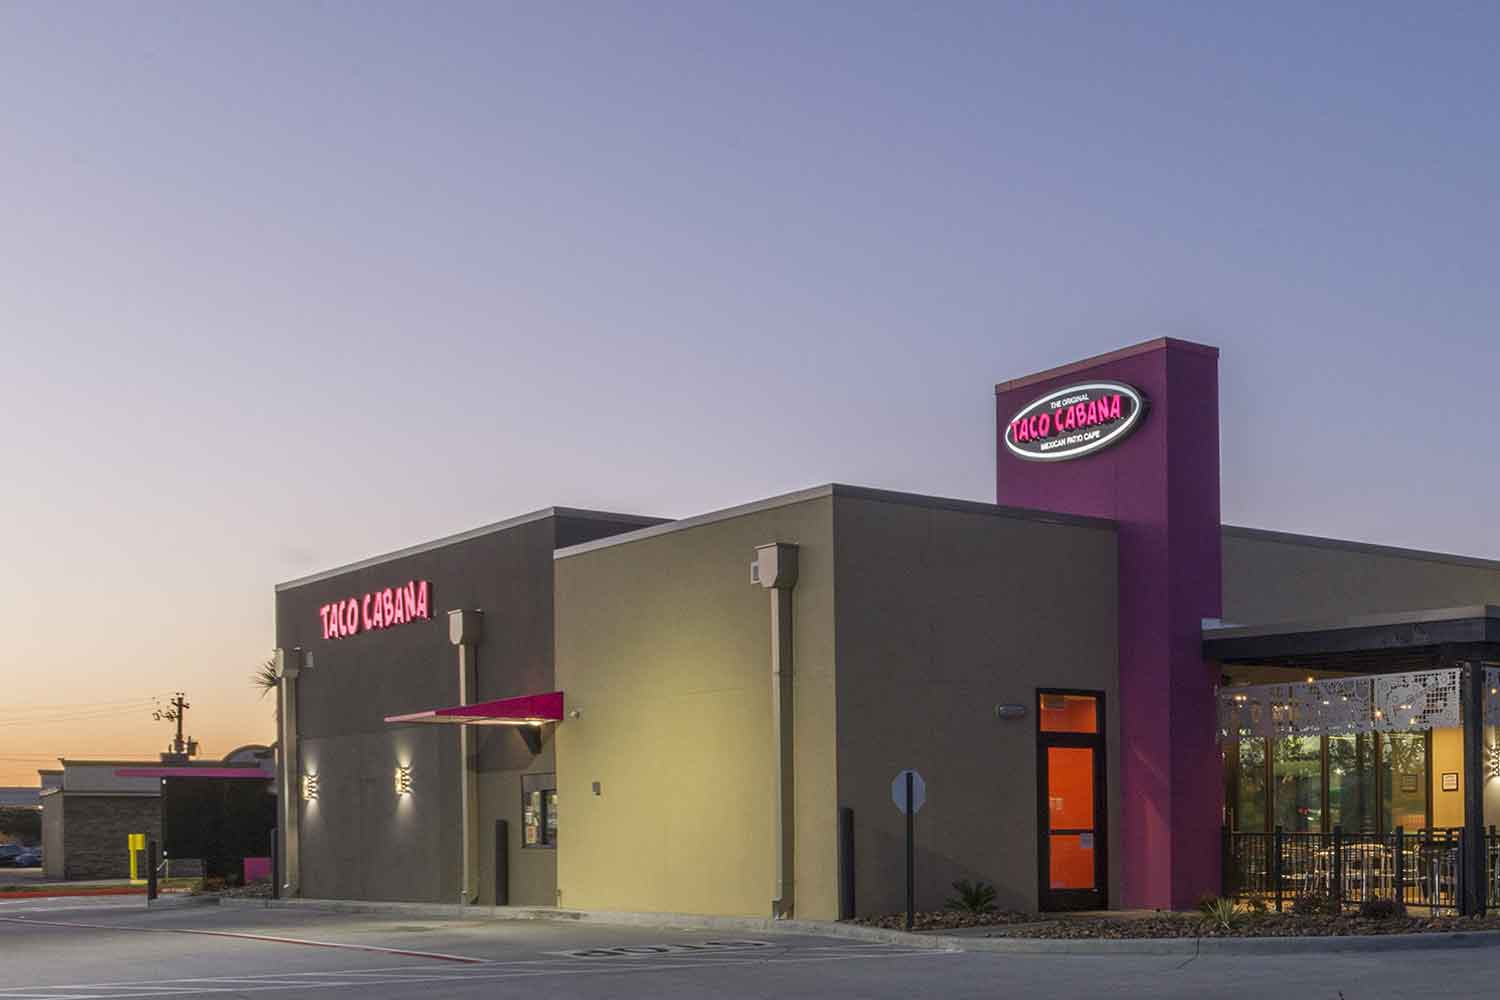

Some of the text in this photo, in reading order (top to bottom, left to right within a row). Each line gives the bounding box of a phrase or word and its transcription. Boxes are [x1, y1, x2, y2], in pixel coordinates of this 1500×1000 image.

[1010, 394, 1121, 443] TACO CABANA
[319, 579, 428, 639] TACO CABANA
